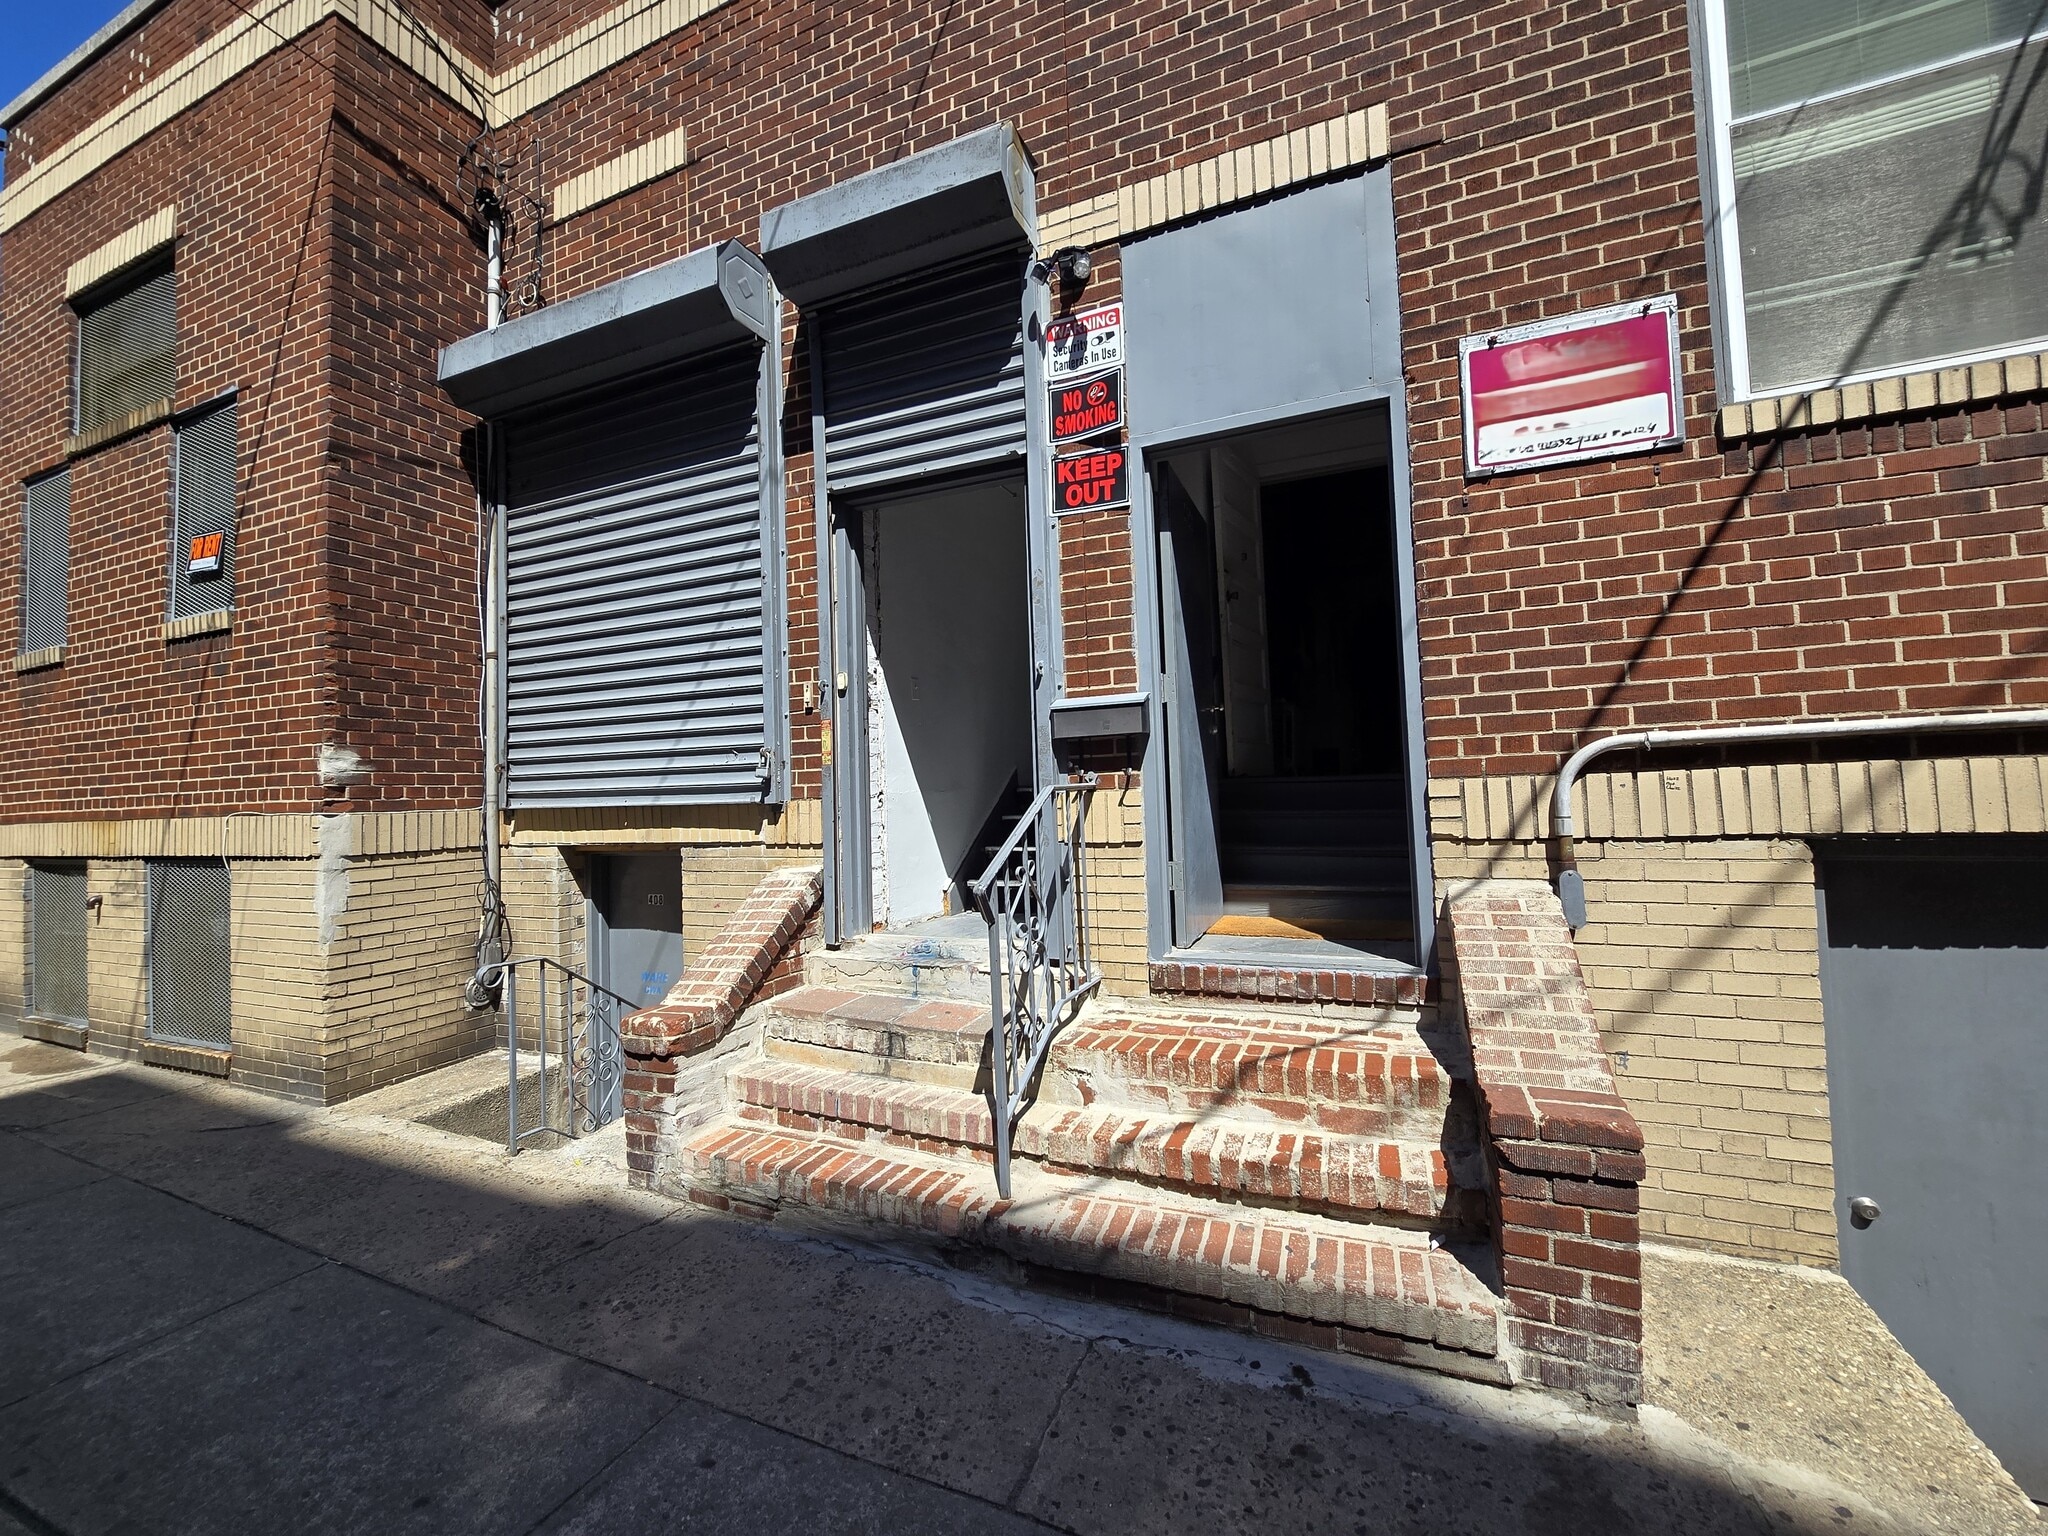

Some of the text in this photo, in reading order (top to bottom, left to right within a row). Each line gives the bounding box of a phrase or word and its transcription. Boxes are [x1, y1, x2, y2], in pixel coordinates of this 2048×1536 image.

[1051, 312, 1116, 340] WARNING
[1053, 340, 1087, 357] Security
[1054, 348, 1117, 372] Cameras In Use
[1063, 390, 1082, 413] NO
[1055, 402, 1116, 436] SMOKING
[1057, 452, 1122, 484] KEEP
[1065, 479, 1116, 507] OUT
[190, 533, 222, 560] FOR RENT
[648, 894, 664, 905] 408
